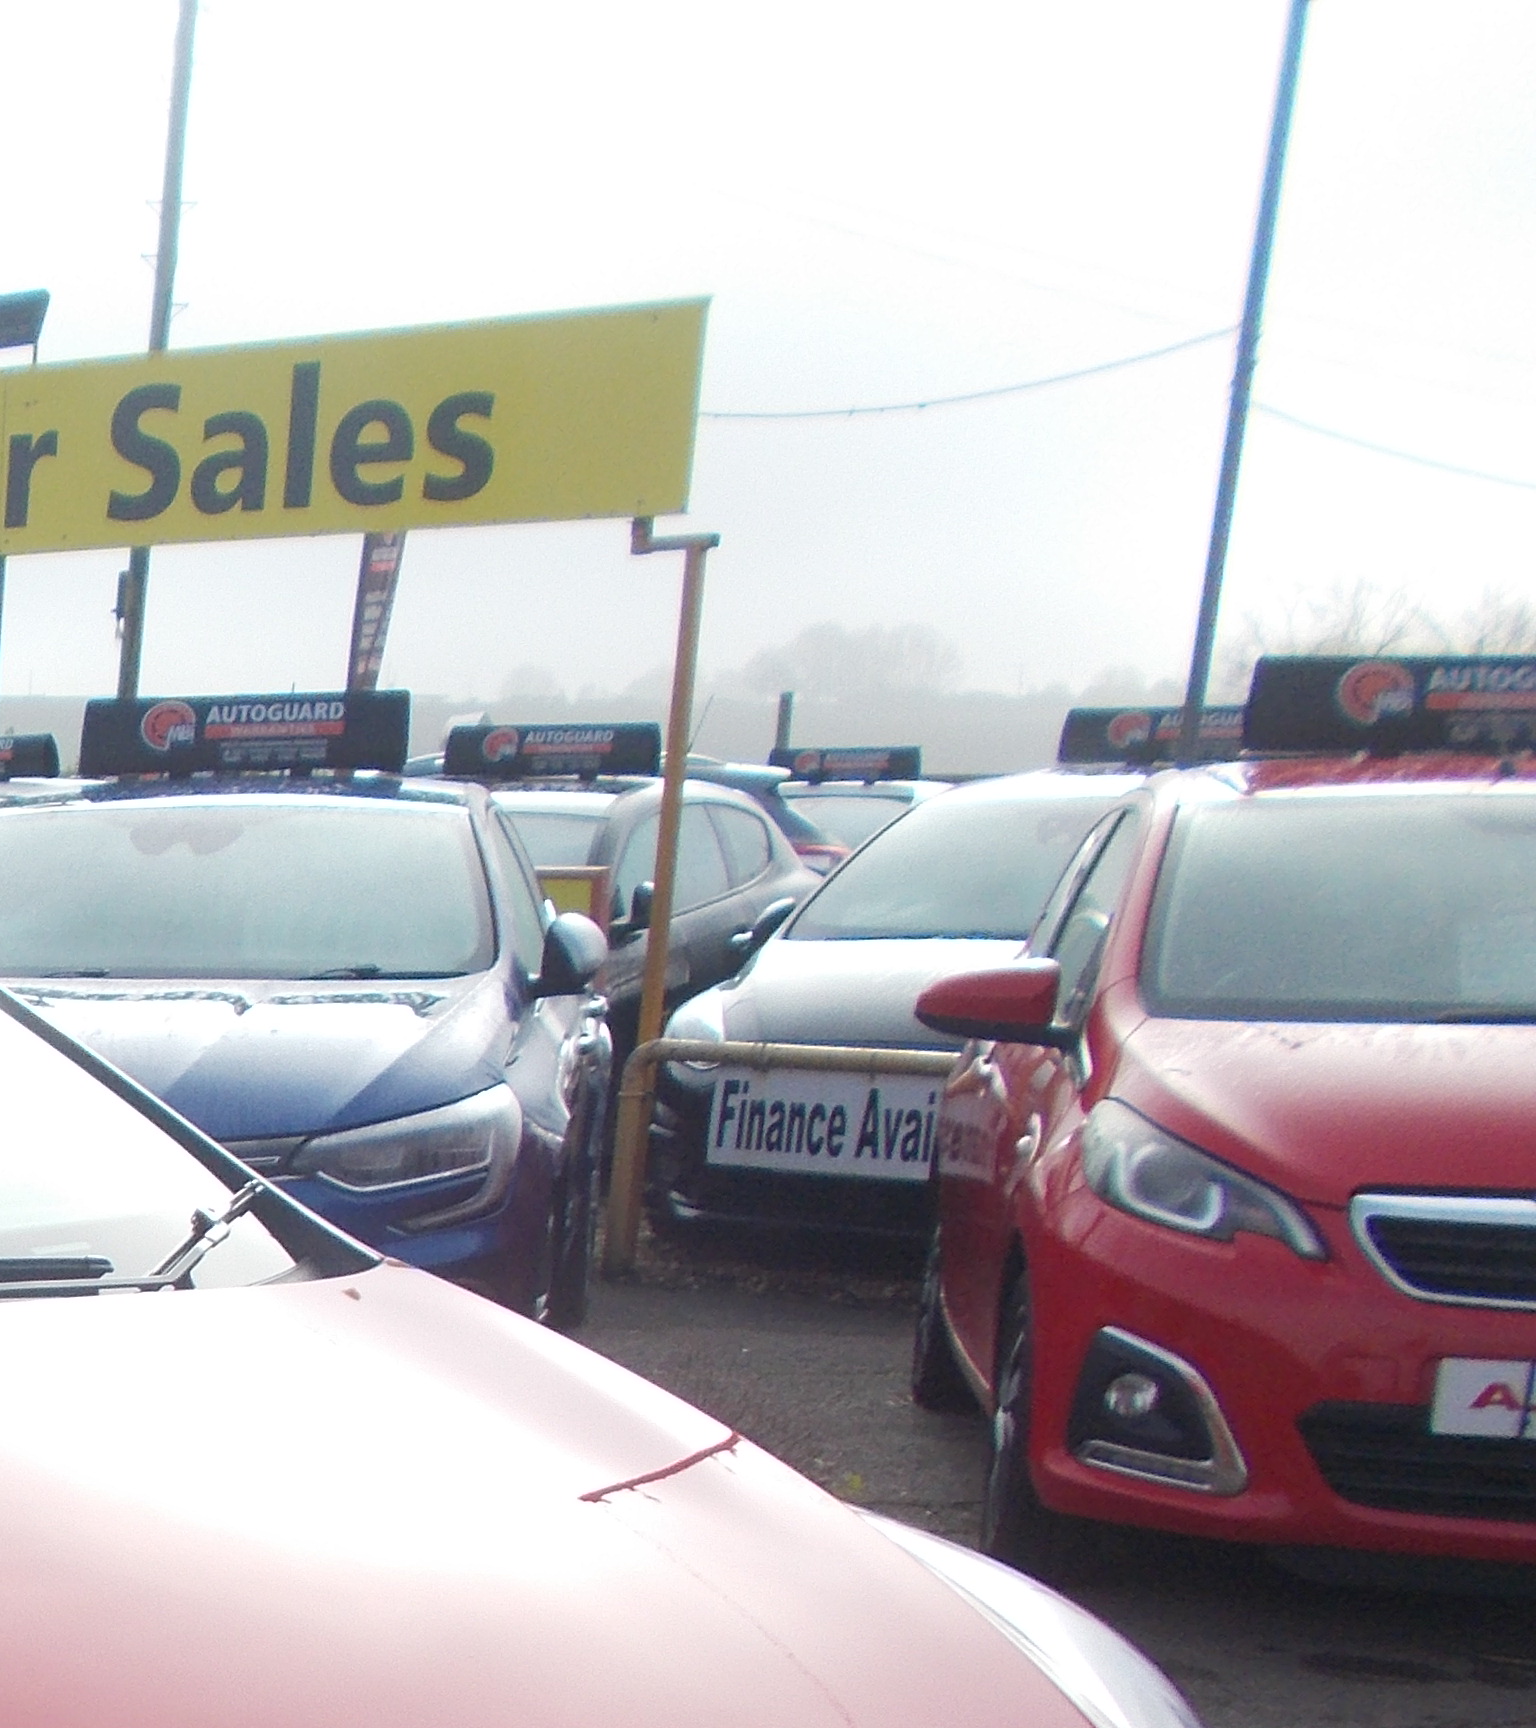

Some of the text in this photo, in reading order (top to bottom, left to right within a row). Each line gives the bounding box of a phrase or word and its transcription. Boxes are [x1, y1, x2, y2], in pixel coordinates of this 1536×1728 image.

[107, 361, 496, 523] Sales
[205, 701, 345, 724] AUTOGUARD
[714, 1079, 847, 1158] Finance
